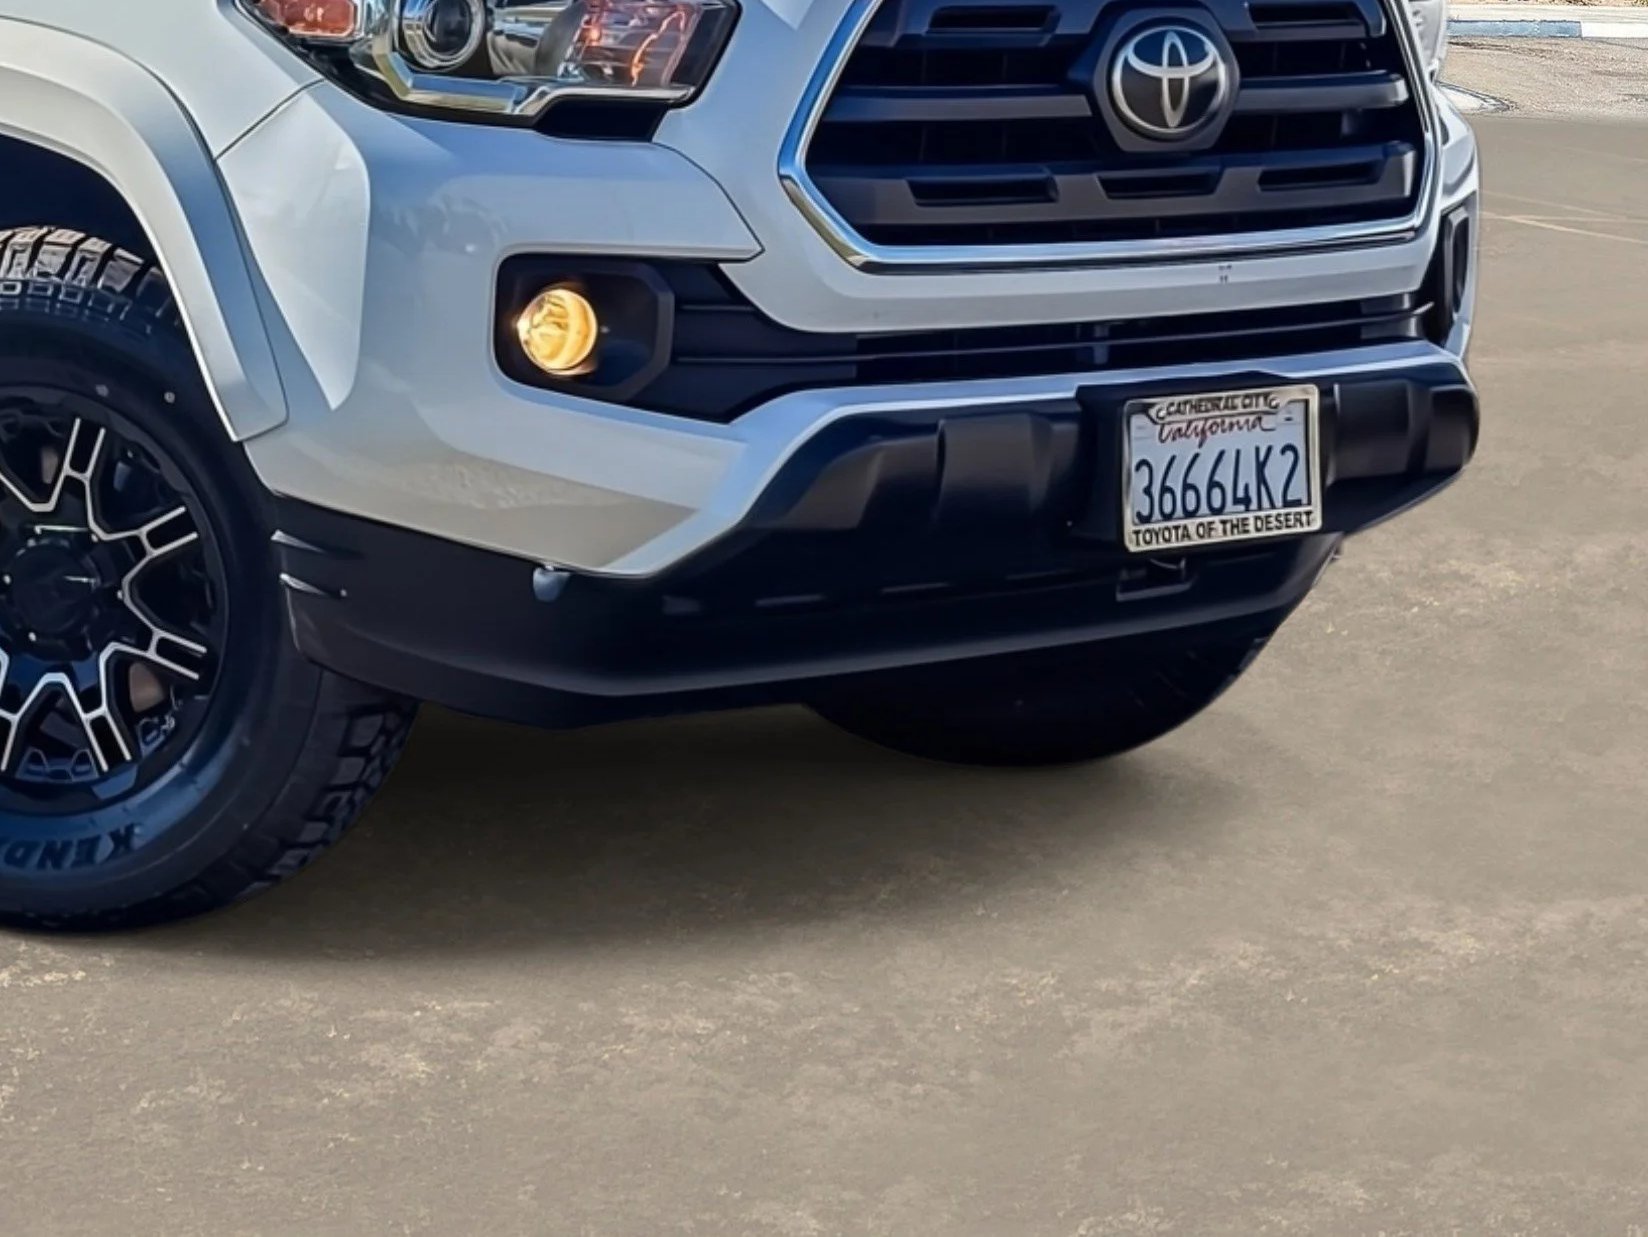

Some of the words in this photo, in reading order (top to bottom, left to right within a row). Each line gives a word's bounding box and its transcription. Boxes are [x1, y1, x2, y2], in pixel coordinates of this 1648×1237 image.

[1166, 395, 1238, 416] CATHEDRAL
[1241, 393, 1271, 410] CITY
[1134, 442, 1302, 525] 36664K2
[1132, 524, 1192, 547] TOYOTA
[1195, 520, 1218, 539] OF
[1219, 516, 1251, 536] THE
[1254, 510, 1314, 533] DESERT
